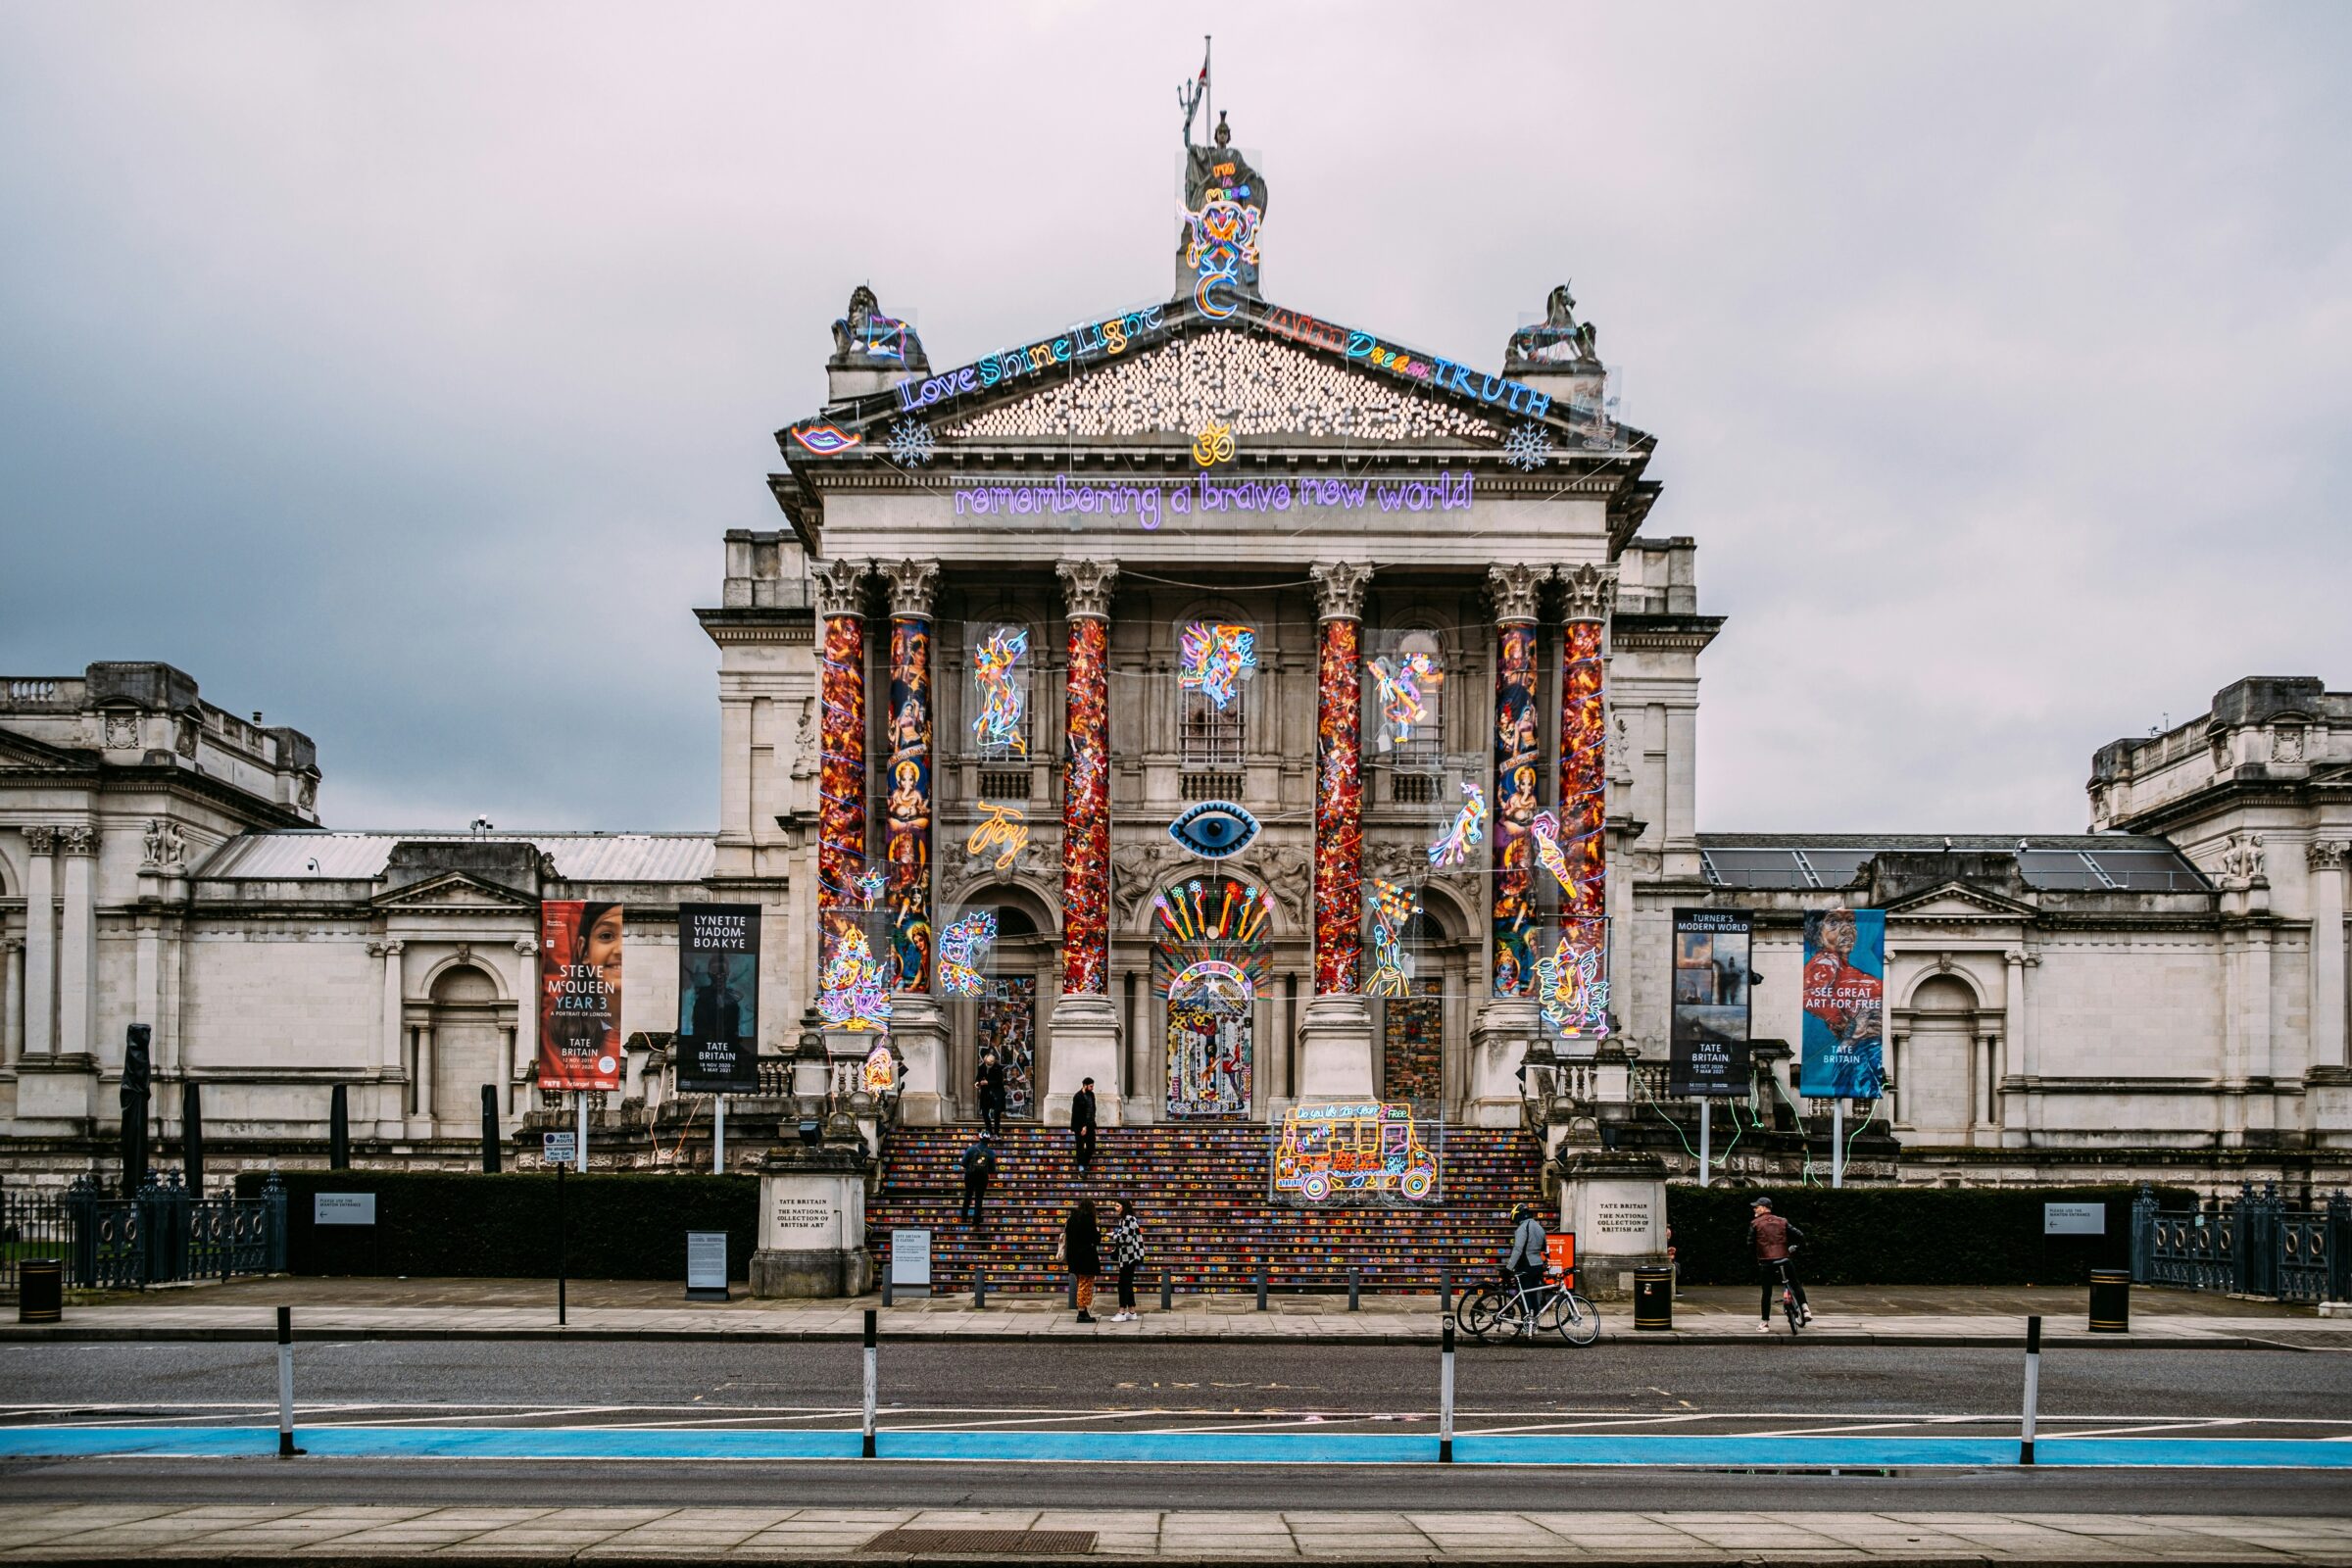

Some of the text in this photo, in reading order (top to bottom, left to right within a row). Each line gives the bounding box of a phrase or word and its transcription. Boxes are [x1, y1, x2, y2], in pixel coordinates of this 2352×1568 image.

[896, 305, 1163, 413] Love Shine Light
[1266, 305, 1347, 354] Aim
[1434, 354, 1553, 417] TRUTH
[955, 470, 1473, 530] remembering a brave new world
[967, 800, 1028, 869] Joy
[694, 915, 746, 927] LYNETTE
[1692, 913, 1734, 923] TURNER'S
[694, 926, 746, 937] YIADOM-
[1678, 922, 1748, 932] MODERN WORLD
[694, 938, 745, 949] BOAKYE
[560, 964, 604, 978] STEVE
[1815, 988, 1872, 998] SEE GREAT
[555, 996, 608, 1010] YEAR 3
[1805, 999, 1882, 1009] ART FOR FREE
[569, 1038, 591, 1048] TATE
[707, 1042, 728, 1051] TATE
[562, 1048, 598, 1057] BRITAIN
[1699, 1044, 1722, 1053] TATE
[1831, 1046, 1853, 1054] TATE
[699, 1052, 736, 1061] BRITAIN
[1691, 1053, 1729, 1062] BRITAIN
[1823, 1054, 1860, 1063] BRITAIN
